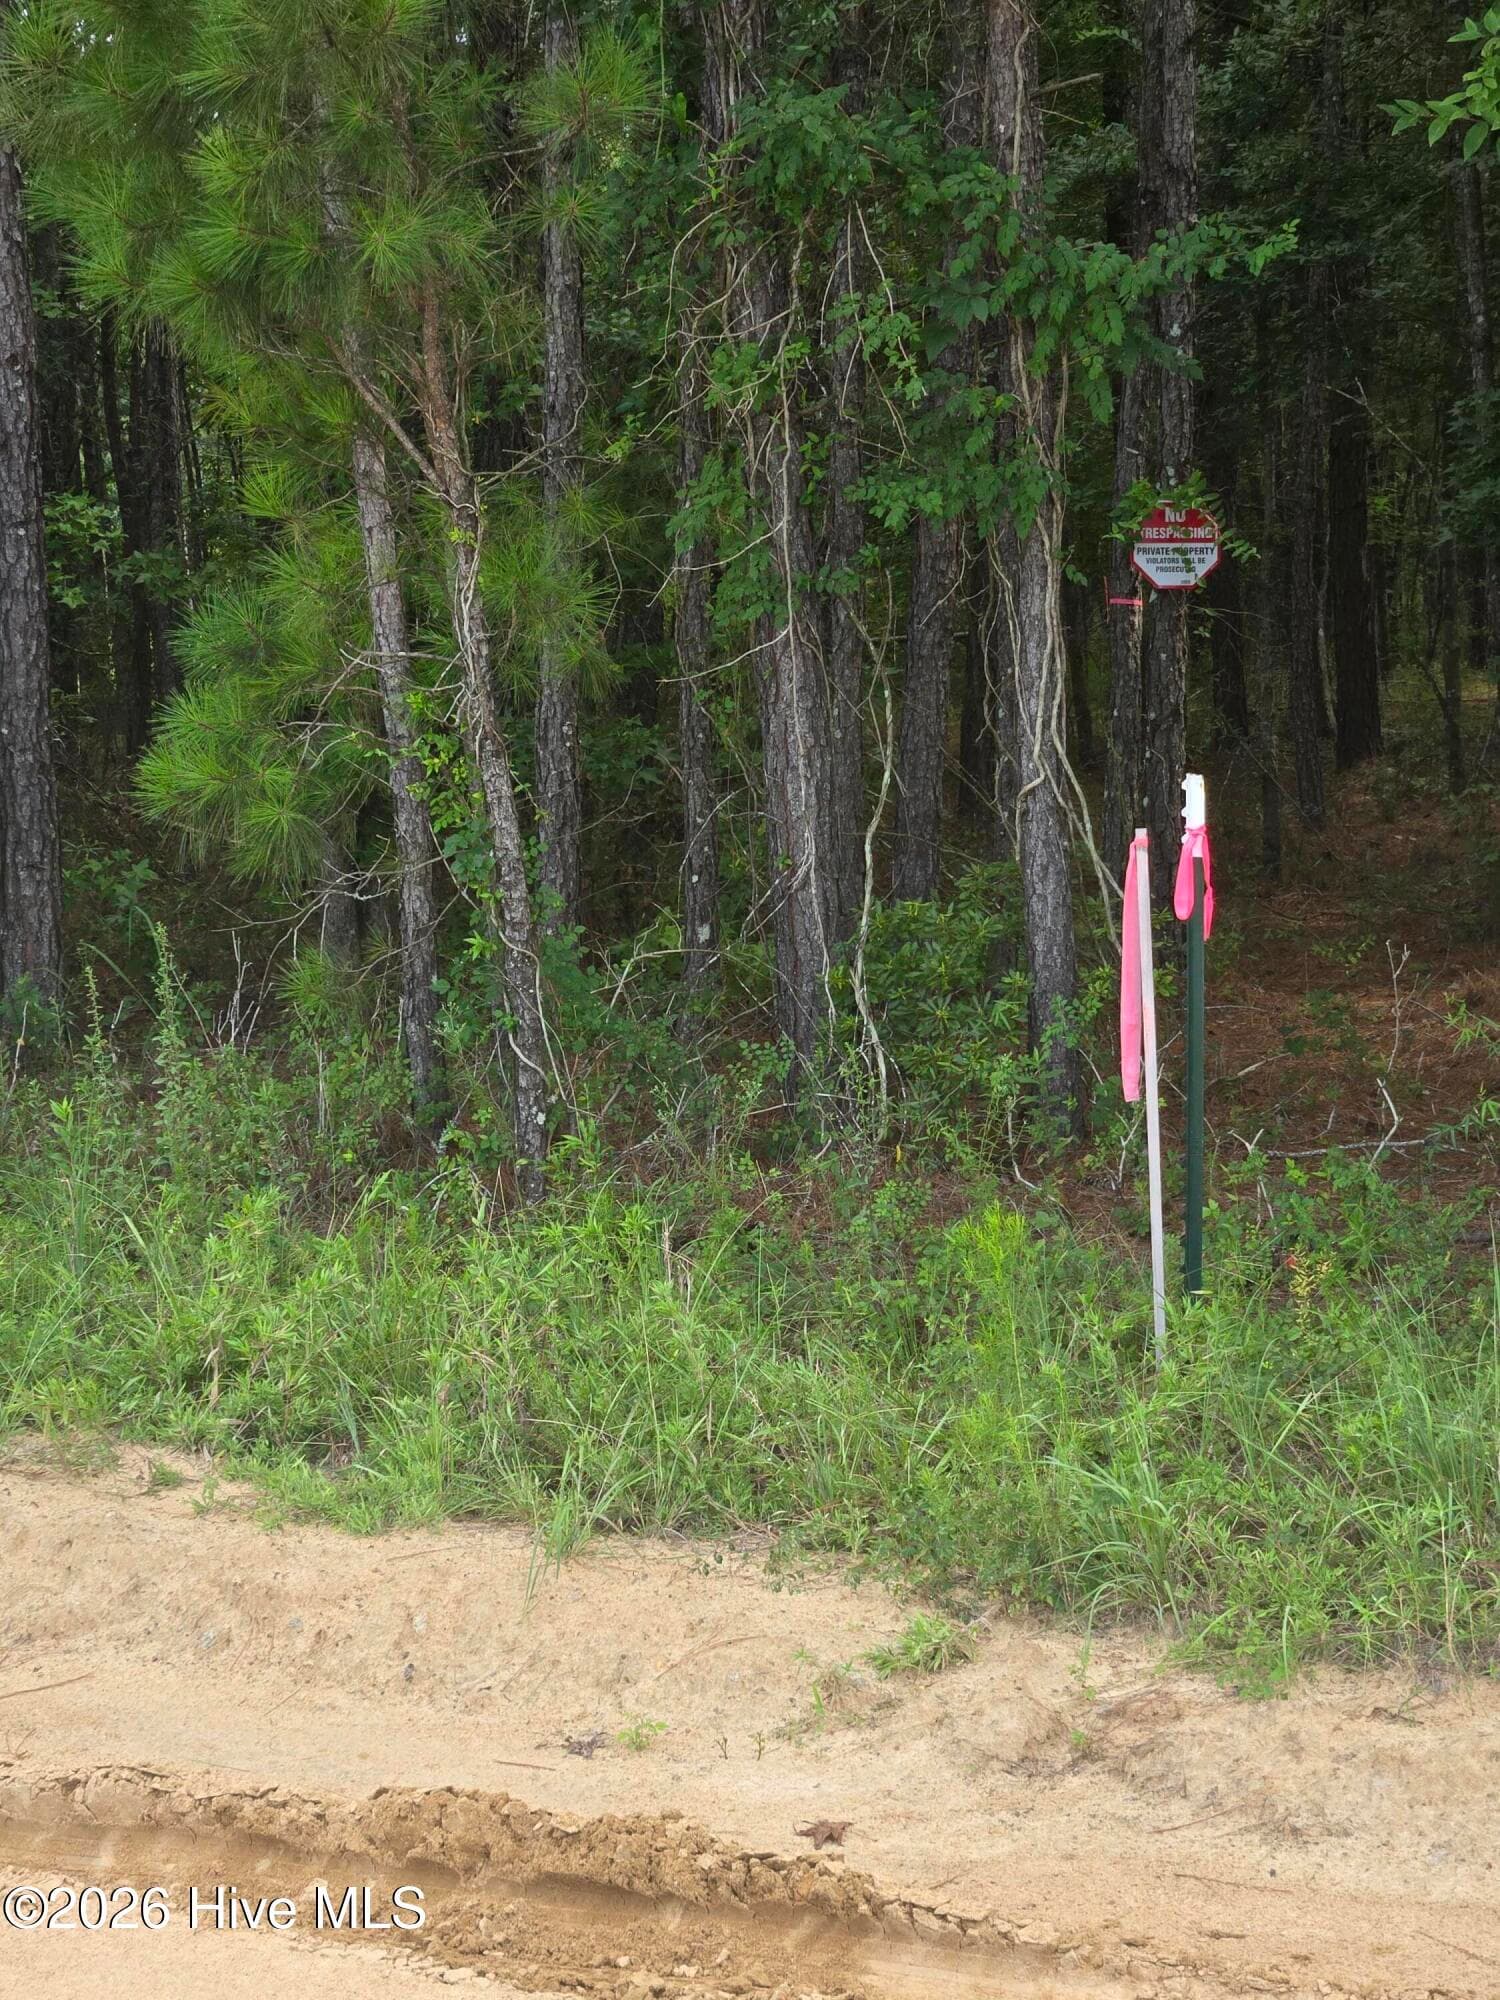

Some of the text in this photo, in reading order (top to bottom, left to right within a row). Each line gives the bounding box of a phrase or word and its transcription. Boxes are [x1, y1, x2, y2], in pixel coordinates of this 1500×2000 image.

[1164, 507, 1186, 522] NO
[1137, 547, 1215, 555] PRIVATE OPERTY
